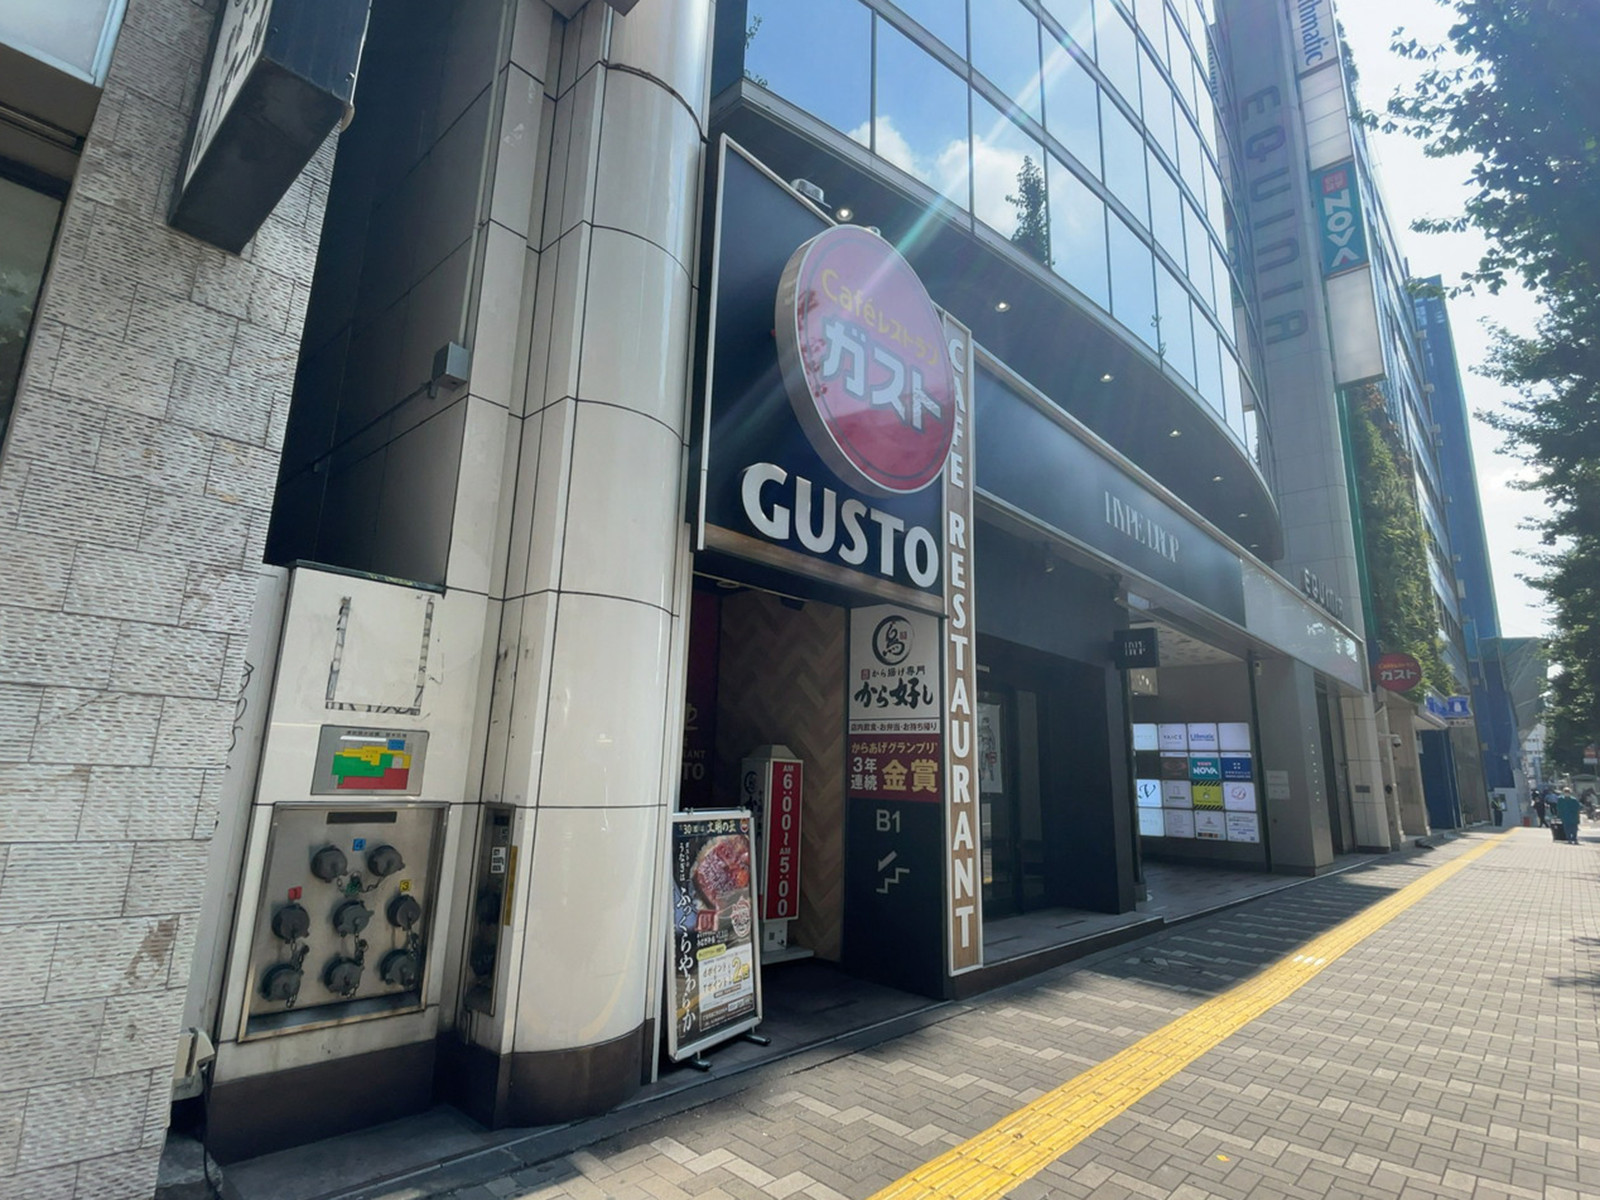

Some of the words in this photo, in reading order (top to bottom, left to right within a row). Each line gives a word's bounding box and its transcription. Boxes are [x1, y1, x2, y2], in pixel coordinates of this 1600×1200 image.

[1324, 189, 1360, 267] NOVA
[822, 320, 942, 431] ガスト
[741, 462, 940, 588] GUSTO
[854, 677, 934, 710] から好し
[948, 511, 974, 948] RESTAURANT
[853, 756, 878, 773] 3年
[882, 758, 938, 793] 金賞
[1193, 767, 1218, 775] NOVA
[851, 774, 878, 791] 連続
[876, 809, 901, 833] B1
[780, 847, 791, 855] AM
[677, 887, 697, 1033] ふっくらやわらか
